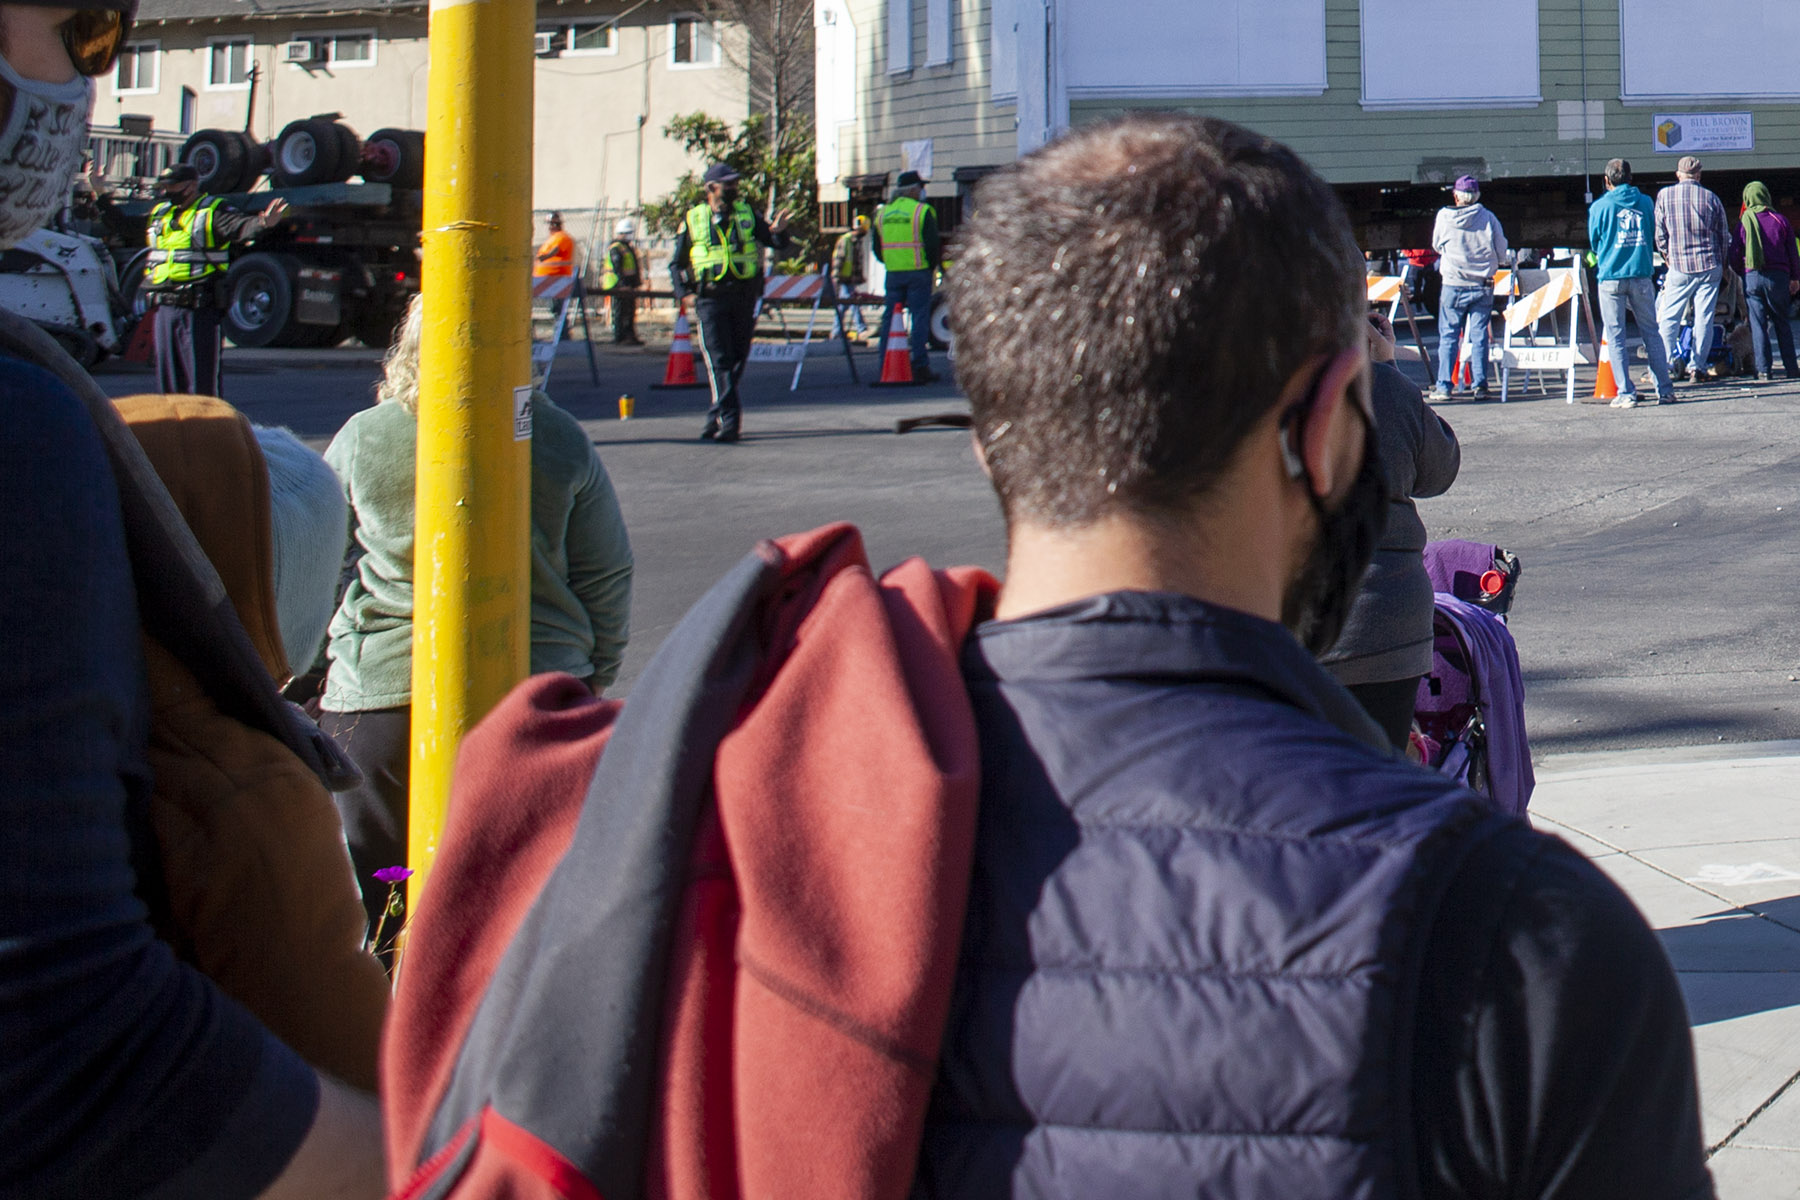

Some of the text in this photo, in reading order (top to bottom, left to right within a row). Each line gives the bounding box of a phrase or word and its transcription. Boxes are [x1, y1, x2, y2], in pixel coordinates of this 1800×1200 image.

[1690, 116, 1748, 127] BILL BROWN
[1517, 351, 1560, 363] CAL VET
